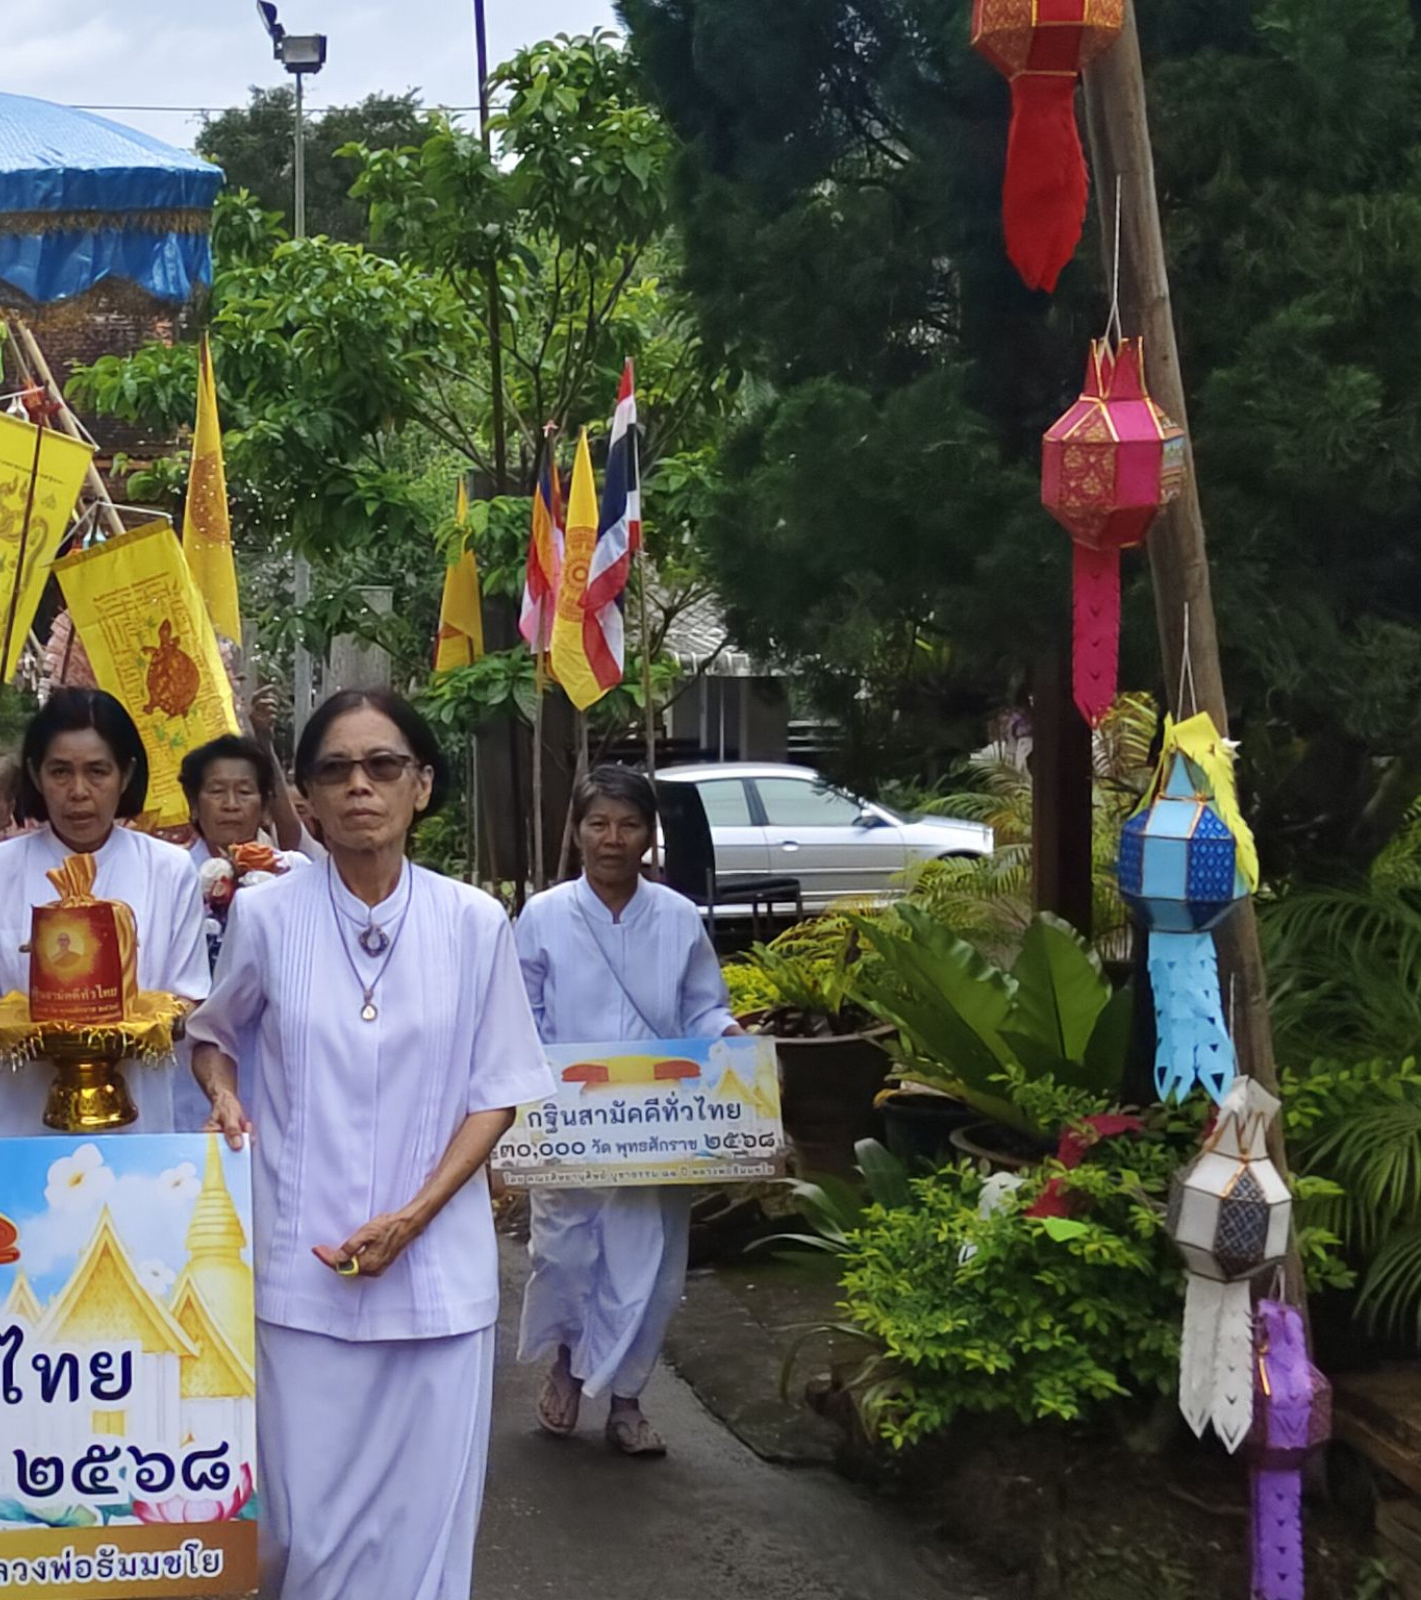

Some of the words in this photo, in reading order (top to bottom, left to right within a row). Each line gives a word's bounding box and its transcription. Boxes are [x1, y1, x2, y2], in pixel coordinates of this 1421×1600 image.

[528, 1092, 742, 1133] กฐินสามัคคีทั่วไทย
[499, 1141, 586, 1160] ๓๐,๐๐๐
[592, 1138, 611, 1155] วัด
[615, 1137, 698, 1158] พุทธศักราช
[704, 1131, 775, 1150] ๒๕๖๘
[13, 1440, 231, 1498] ๒๕๖๘
